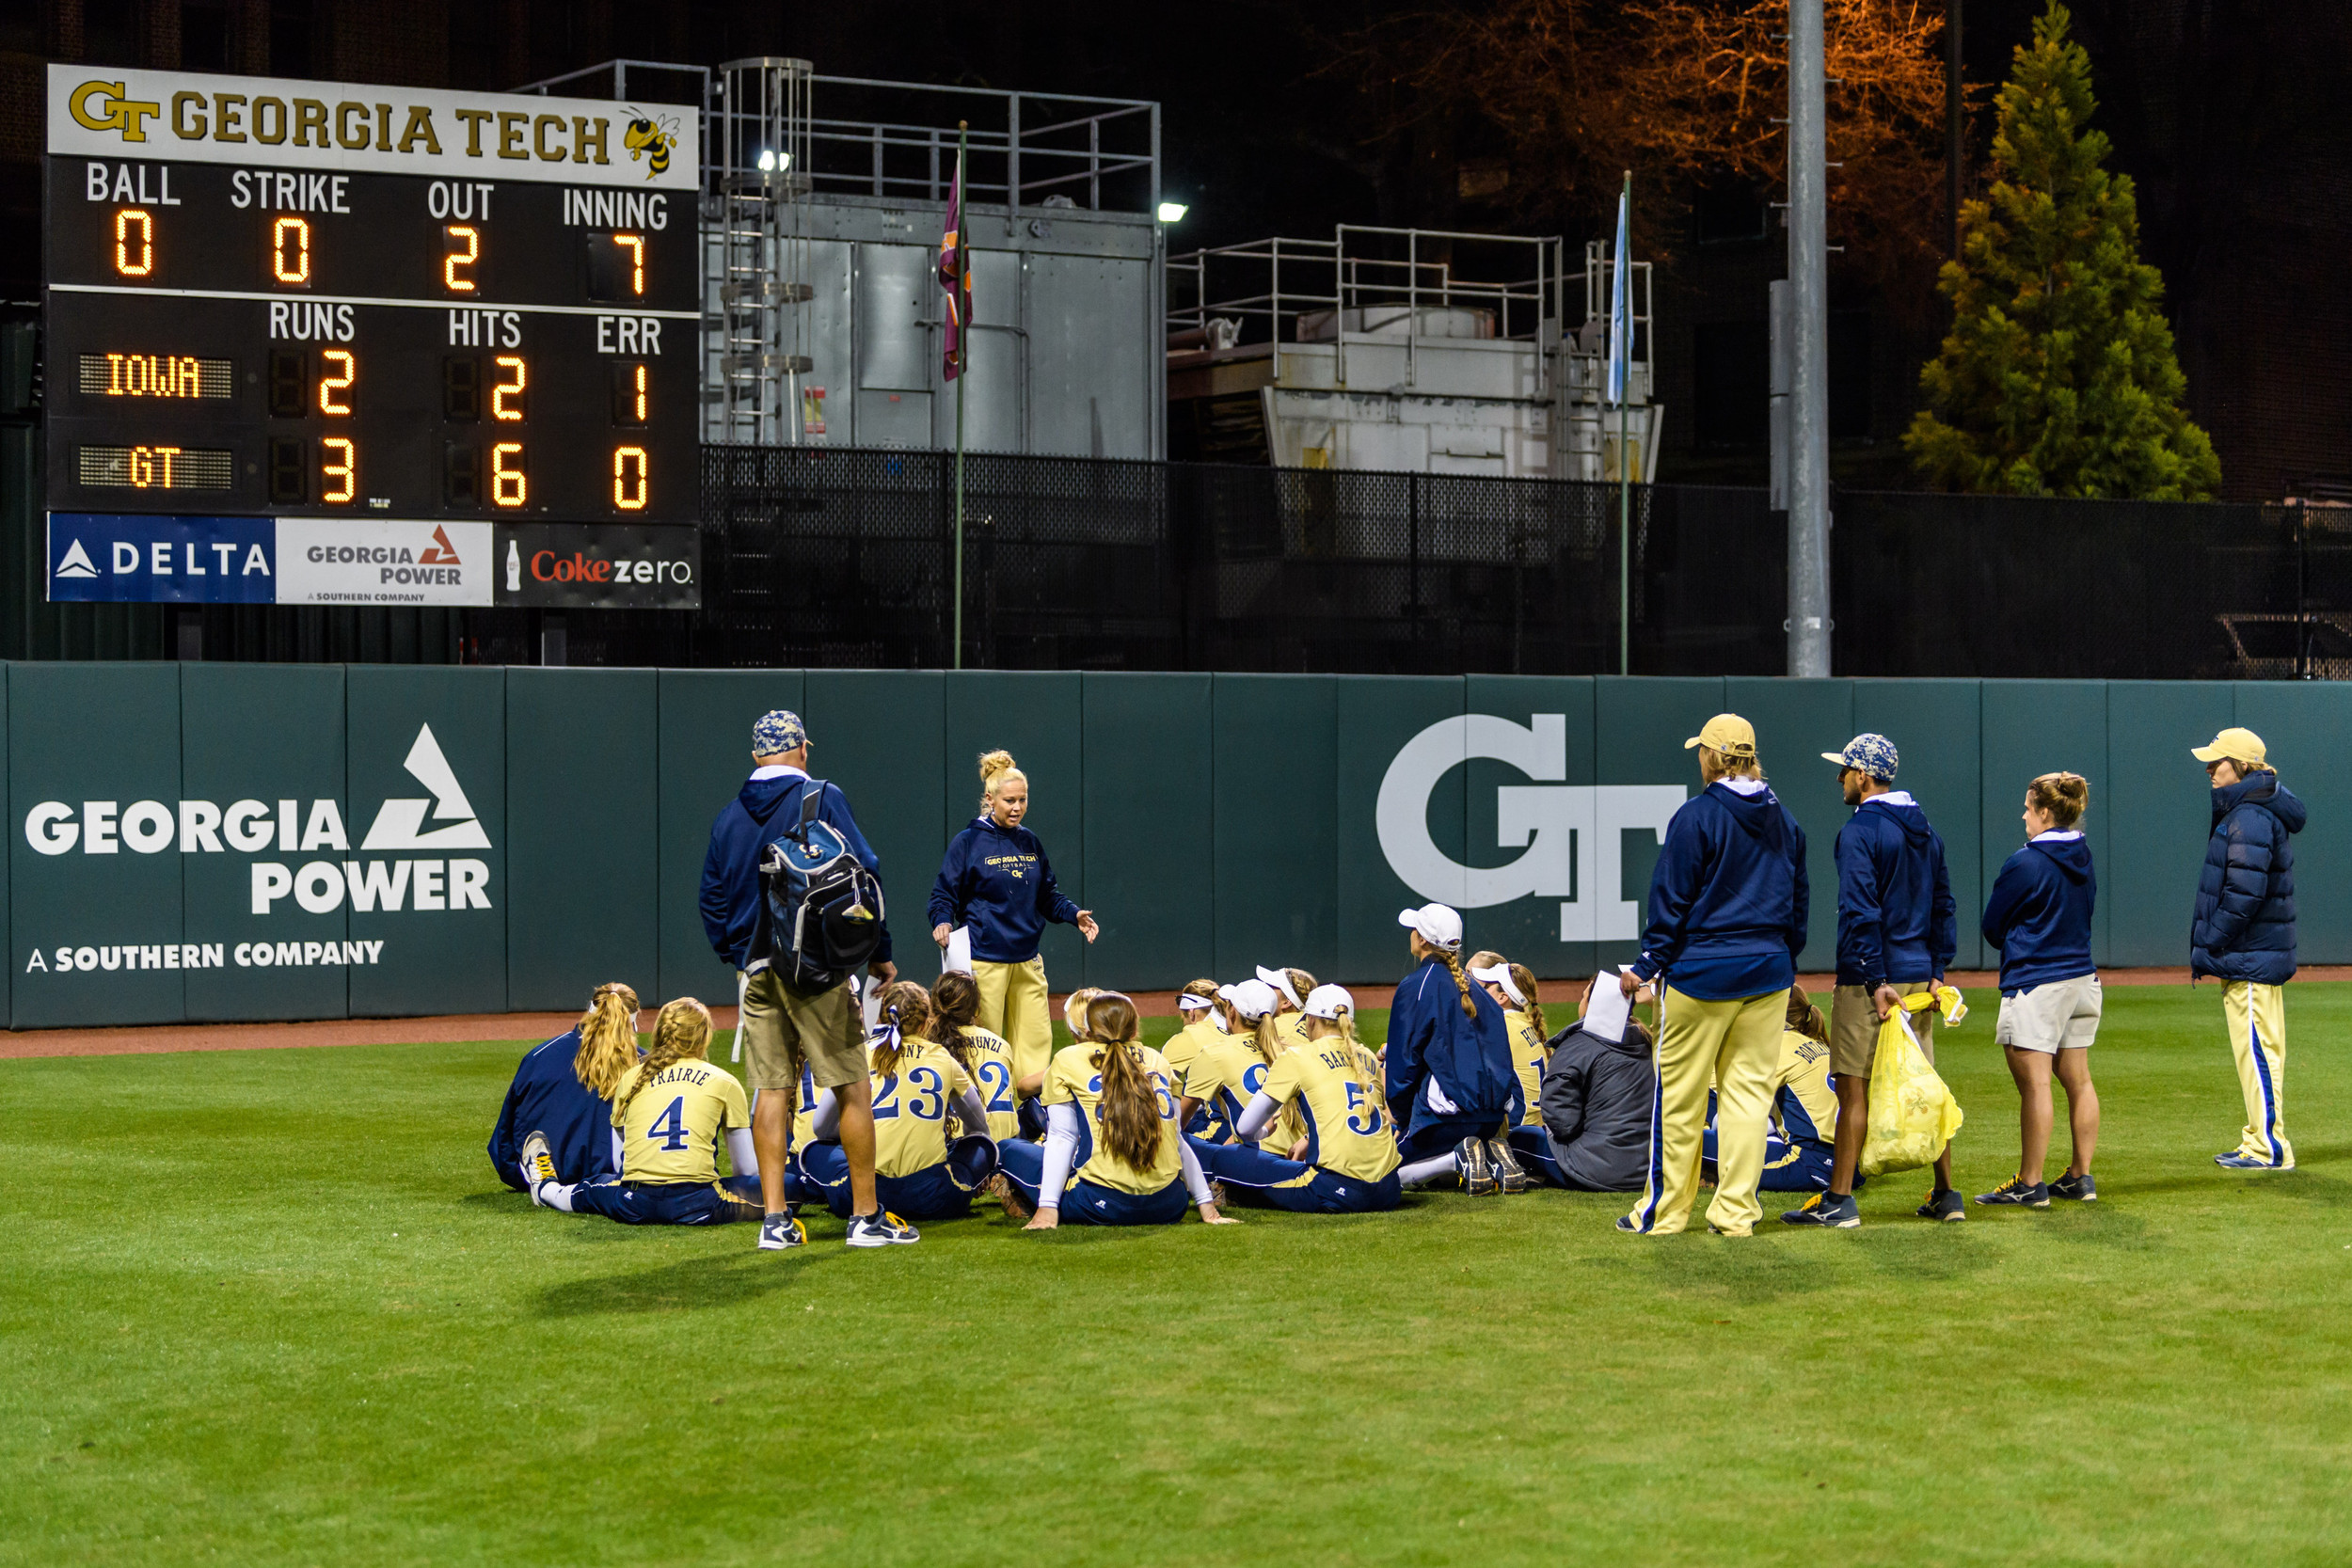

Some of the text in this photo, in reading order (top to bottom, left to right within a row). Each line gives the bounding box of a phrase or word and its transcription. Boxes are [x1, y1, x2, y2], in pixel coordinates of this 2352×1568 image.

[69, 81, 610, 166] GT GEORGIA TECH
[87, 162, 667, 230] BALL STRIKE OUT INNING
[116, 209, 644, 294] 0 0 2 7
[270, 302, 661, 355] RUNS HITS ERR
[106, 350, 646, 420] IOWA 2 2 1
[131, 438, 647, 509] GT 3 6 0
[113, 542, 270, 576] DELTA
[307, 546, 413, 564] GEORGIA
[380, 567, 462, 586] POWER
[531, 550, 611, 582] Coke
[614, 561, 691, 584] zero
[308, 593, 424, 602] A SOUTHERN COMPANY
[24, 800, 350, 855] GEORGIA
[1376, 714, 1687, 942] GT
[251, 859, 492, 914] POWER
[987, 855, 1019, 865] GEORGIA
[26, 941, 384, 974] A SOUTHERN COMPANY
[650, 1068, 710, 1087] PRAIRIE
[647, 1096, 690, 1152] 4
[1343, 1081, 1384, 1136] 5
